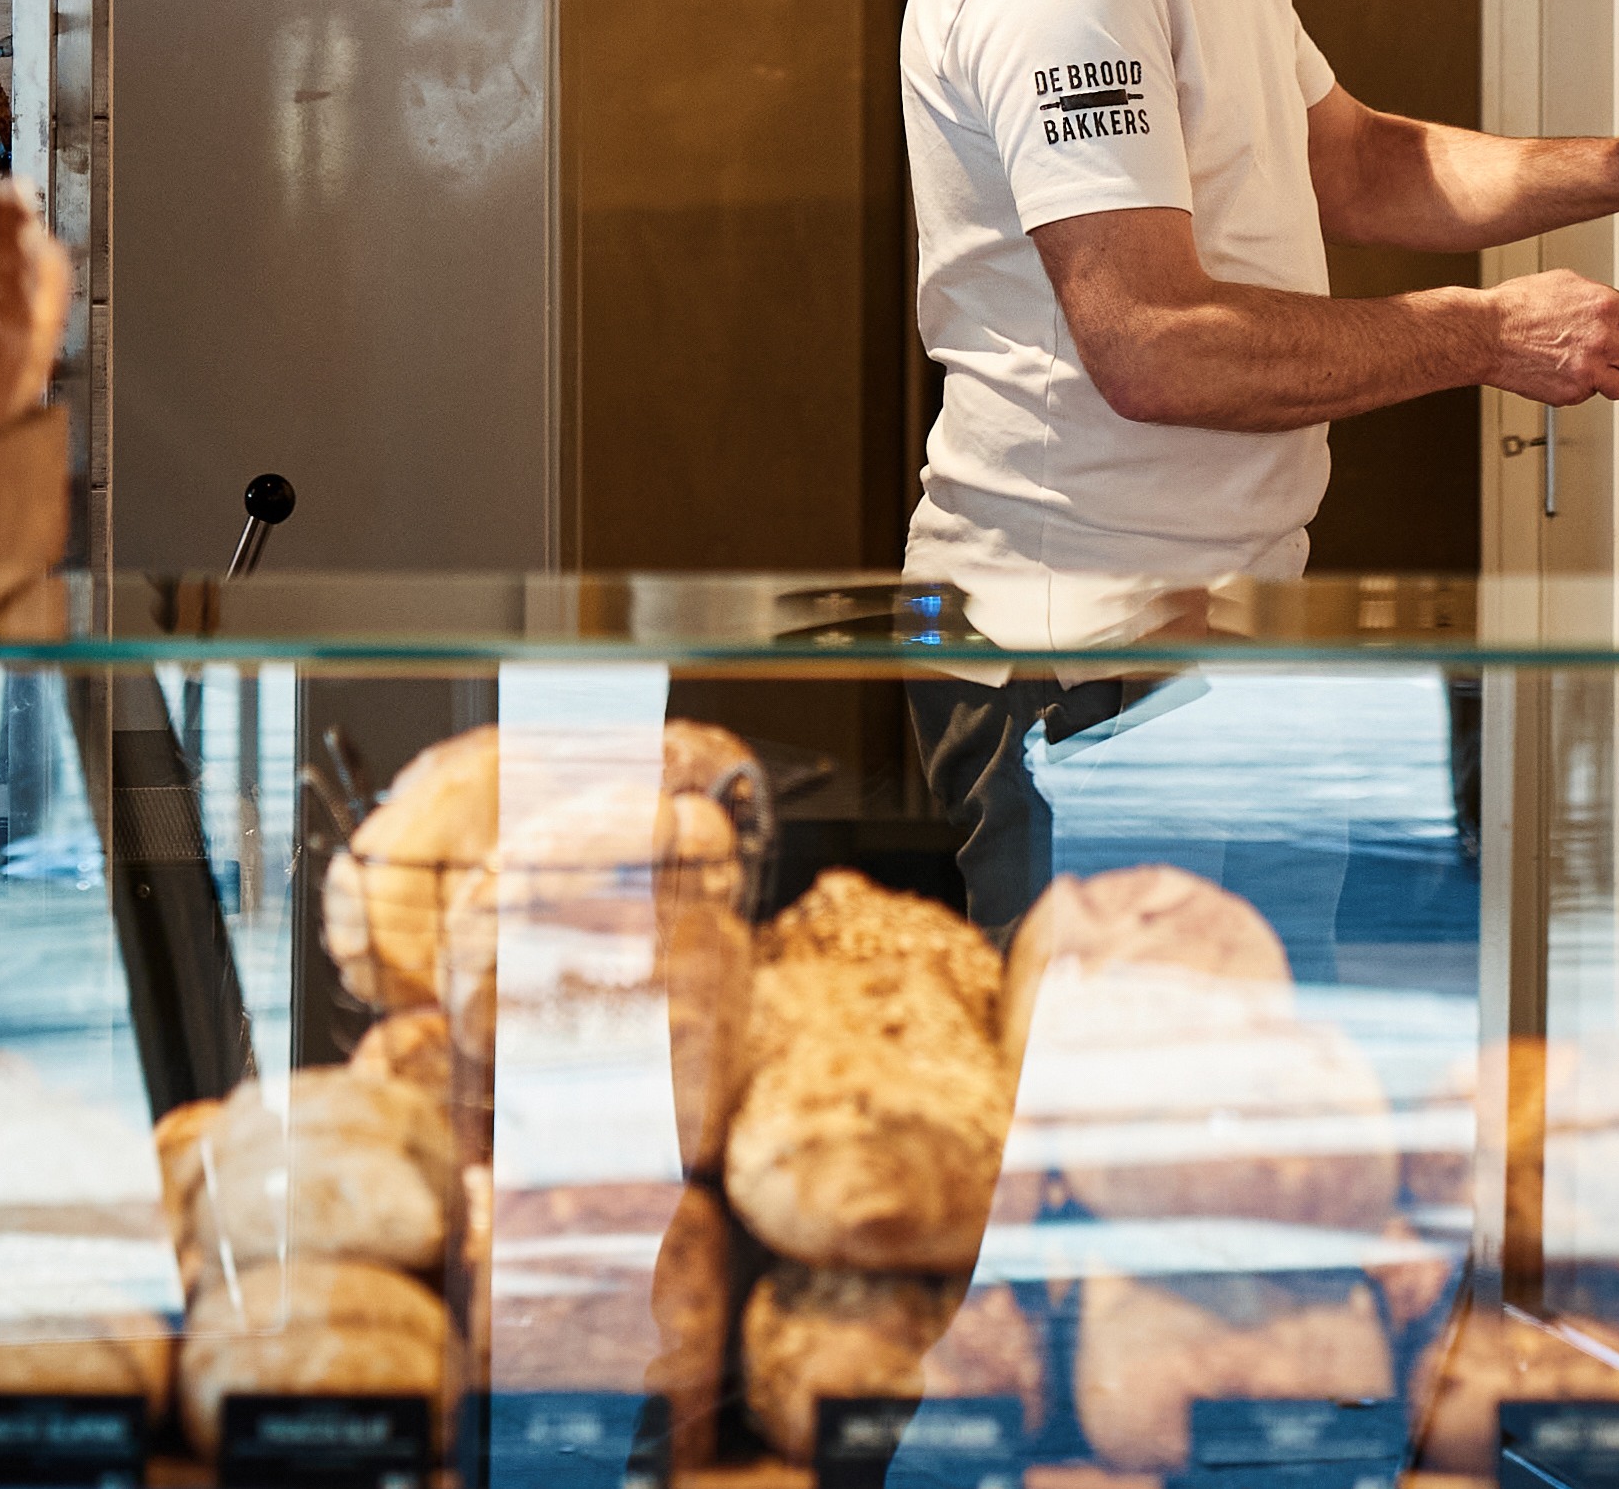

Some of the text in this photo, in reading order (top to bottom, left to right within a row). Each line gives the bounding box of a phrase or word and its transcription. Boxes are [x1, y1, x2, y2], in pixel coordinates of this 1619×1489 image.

[1034, 60, 1142, 96] DE BROOD
[1043, 109, 1150, 145] BAKKERS
